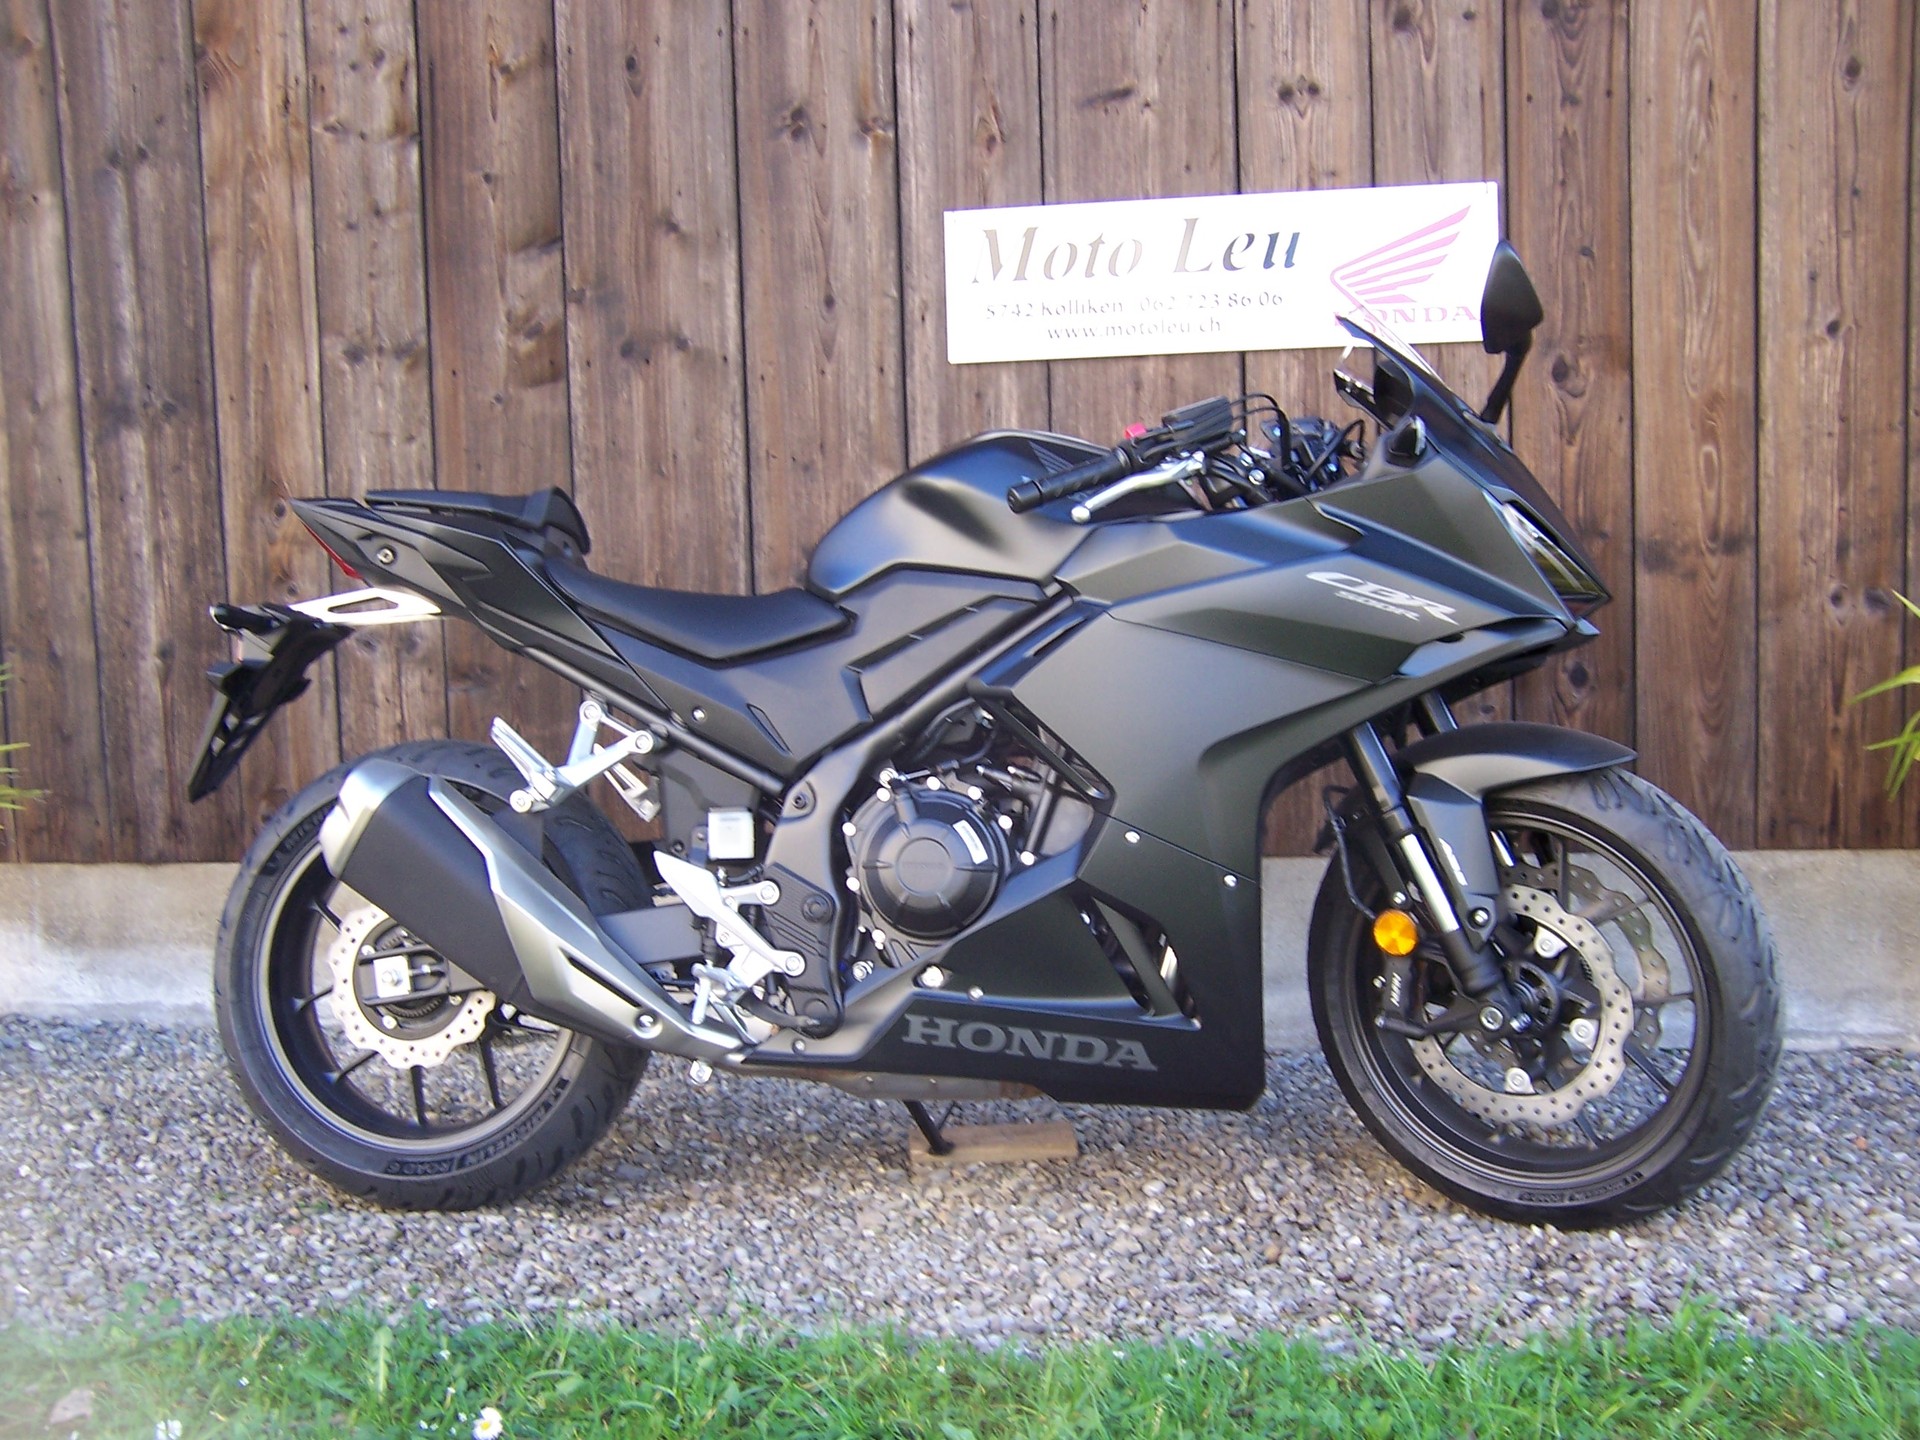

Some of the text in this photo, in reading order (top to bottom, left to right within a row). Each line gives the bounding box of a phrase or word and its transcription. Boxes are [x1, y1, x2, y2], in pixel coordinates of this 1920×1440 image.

[972, 217, 1300, 283] Moto Leu
[1334, 305, 1478, 327] ONDA
[1306, 570, 1460, 627] CBR
[902, 1014, 1158, 1072] HONDA
